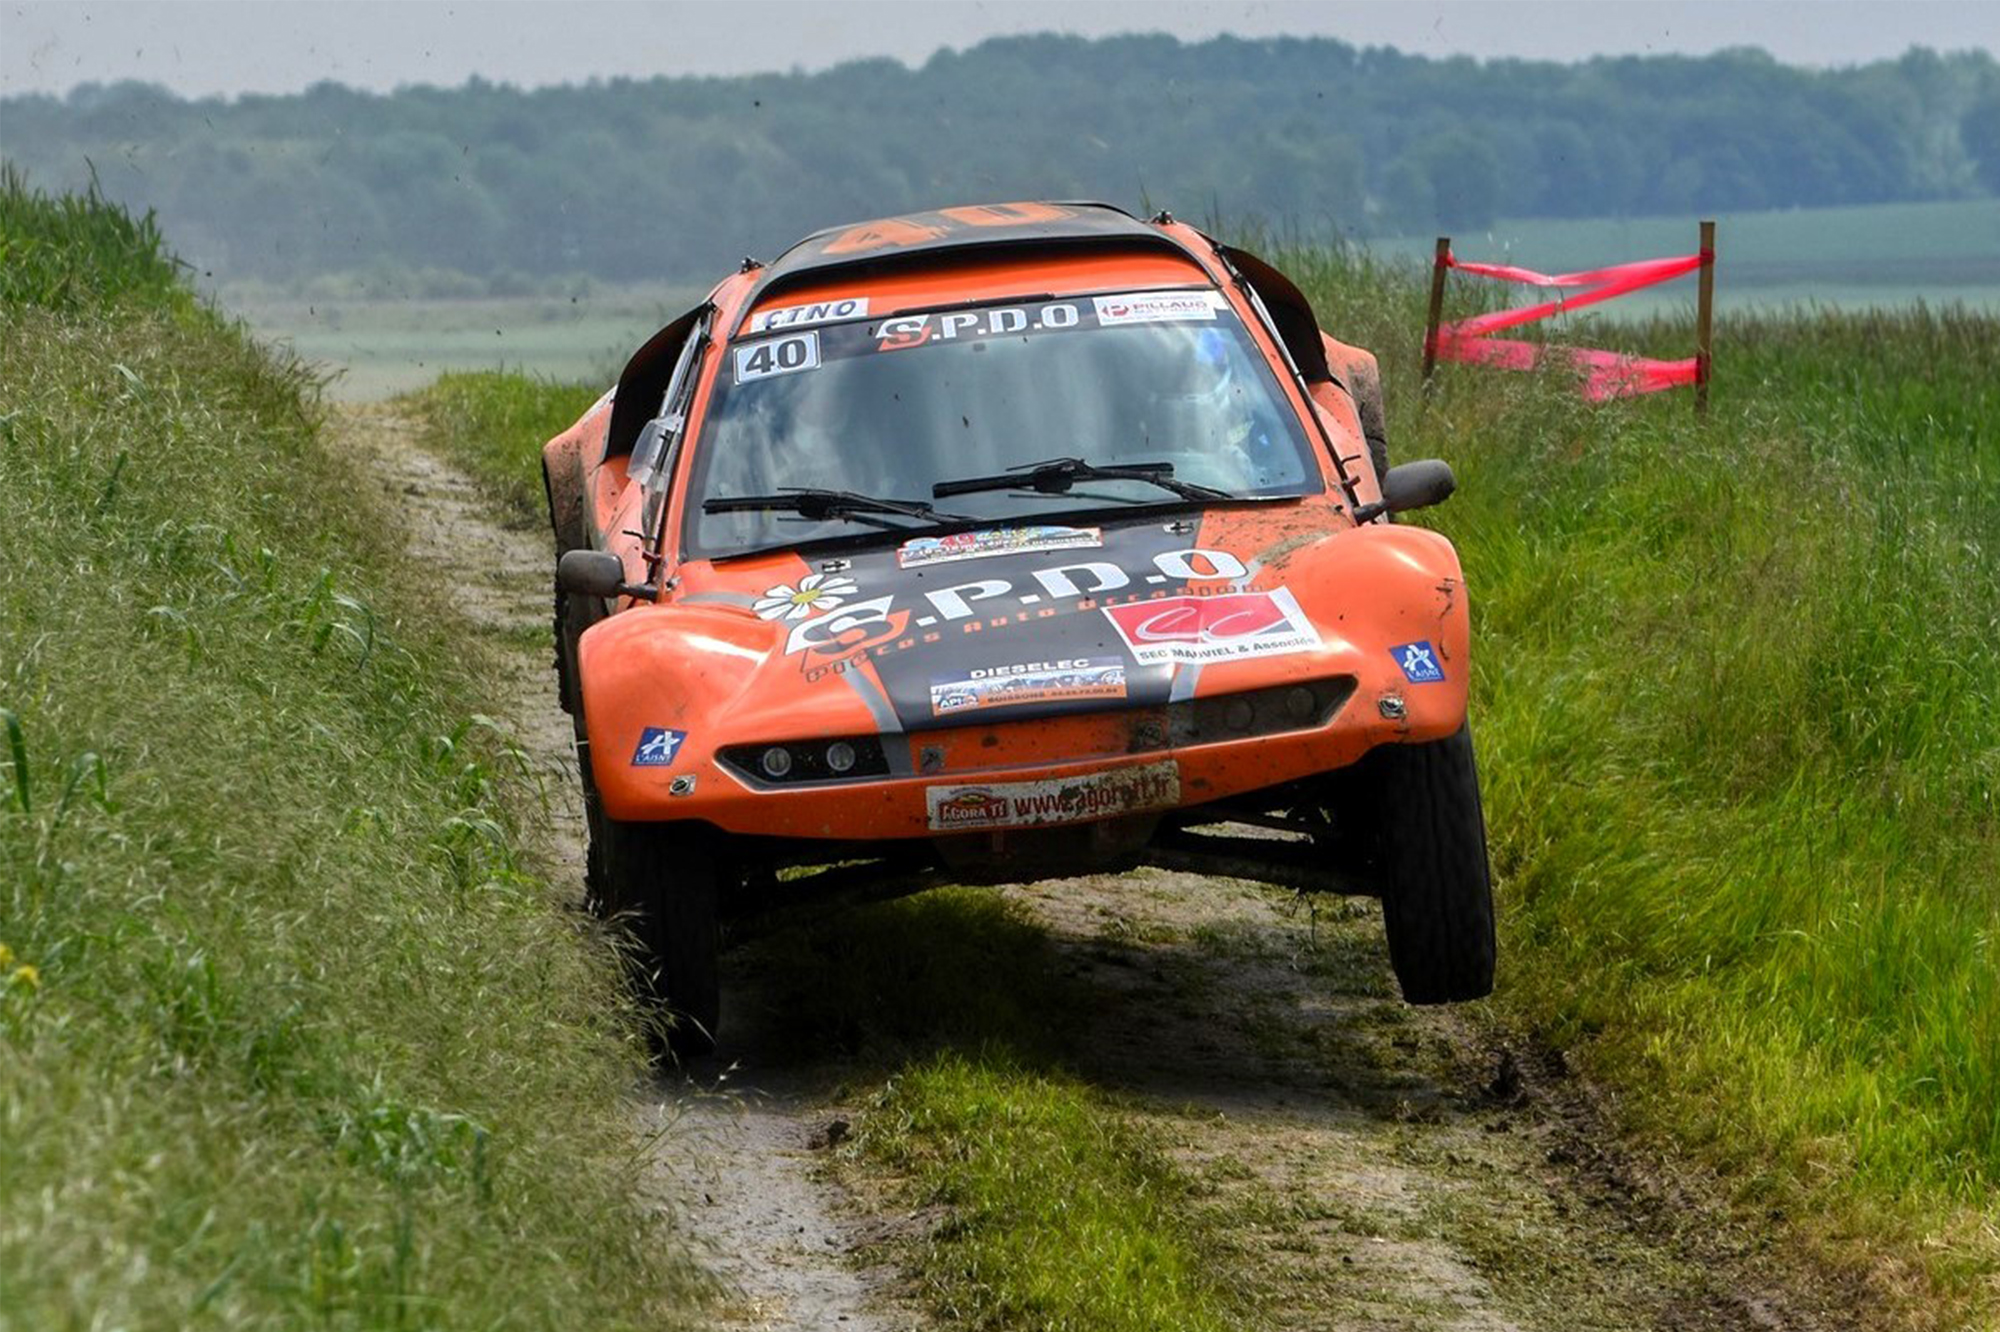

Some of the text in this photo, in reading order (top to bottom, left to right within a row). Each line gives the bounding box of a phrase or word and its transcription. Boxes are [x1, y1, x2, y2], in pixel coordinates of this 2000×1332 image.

[745, 339, 807, 374] 40
[1139, 650, 1168, 660] SEC
[1238, 645, 1249, 653] &
[970, 658, 1090, 680] DIESELEC
[942, 804, 988, 820] AGORA
